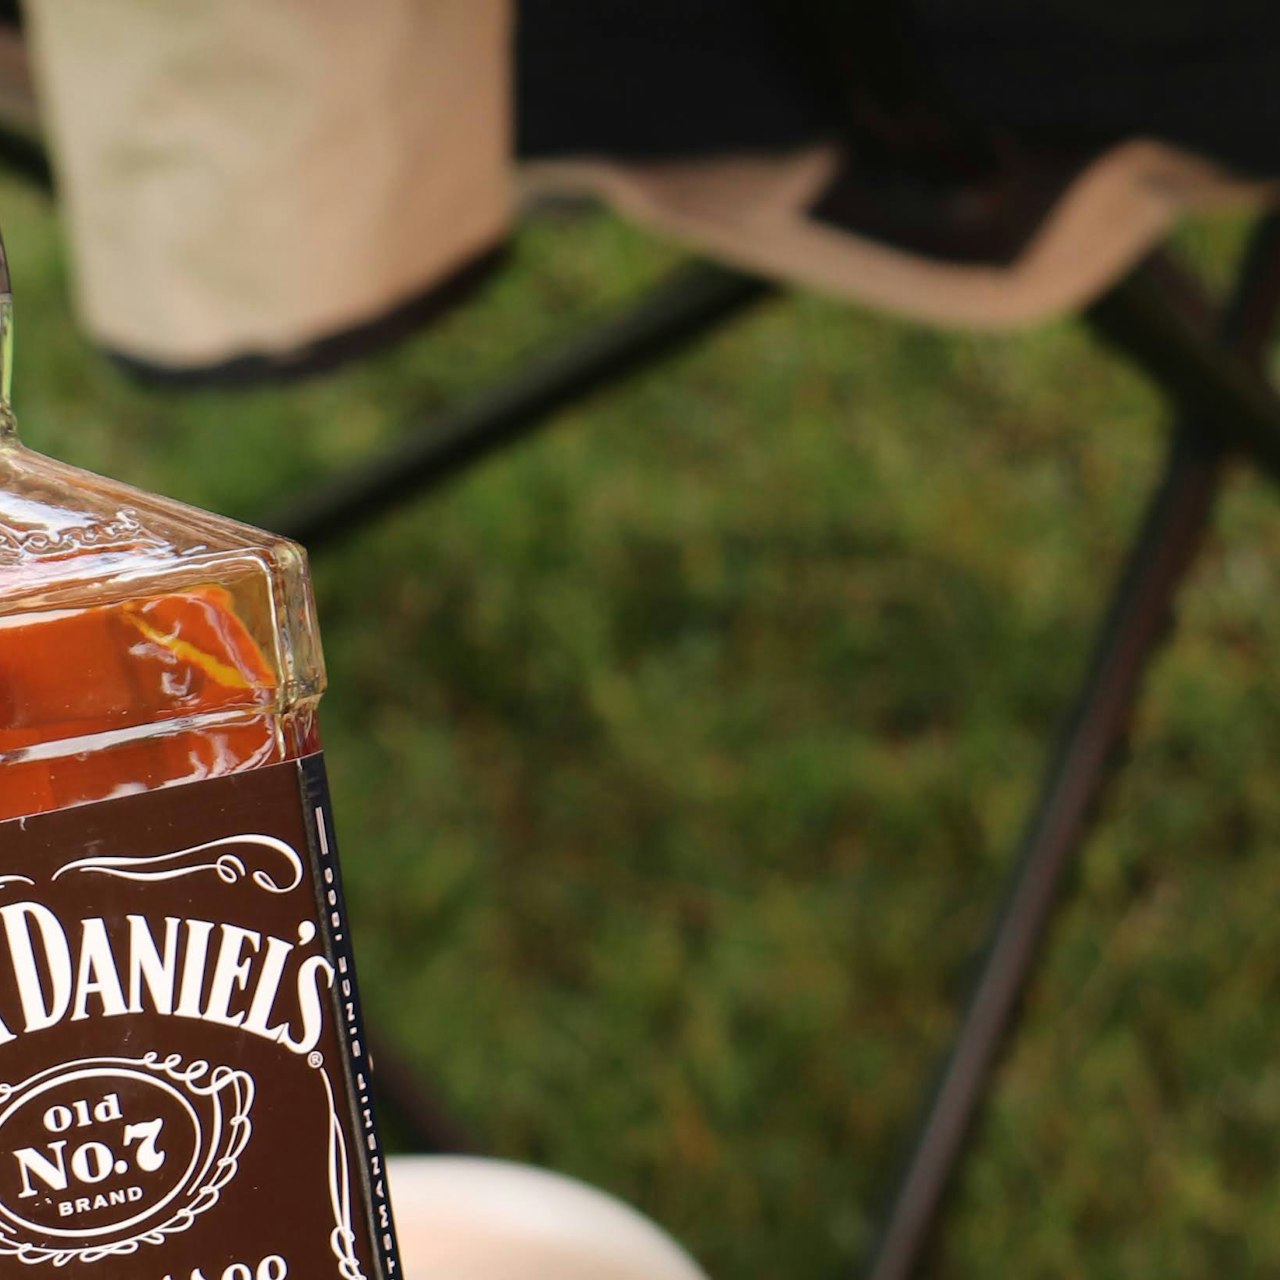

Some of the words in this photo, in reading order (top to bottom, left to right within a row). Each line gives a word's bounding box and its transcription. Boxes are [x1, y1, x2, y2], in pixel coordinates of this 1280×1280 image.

[338, 956, 361, 1058] SINCE
[43, 1093, 123, 1133] Old
[13, 1117, 167, 1199] No.7
[58, 1186, 144, 1218] BRAND
